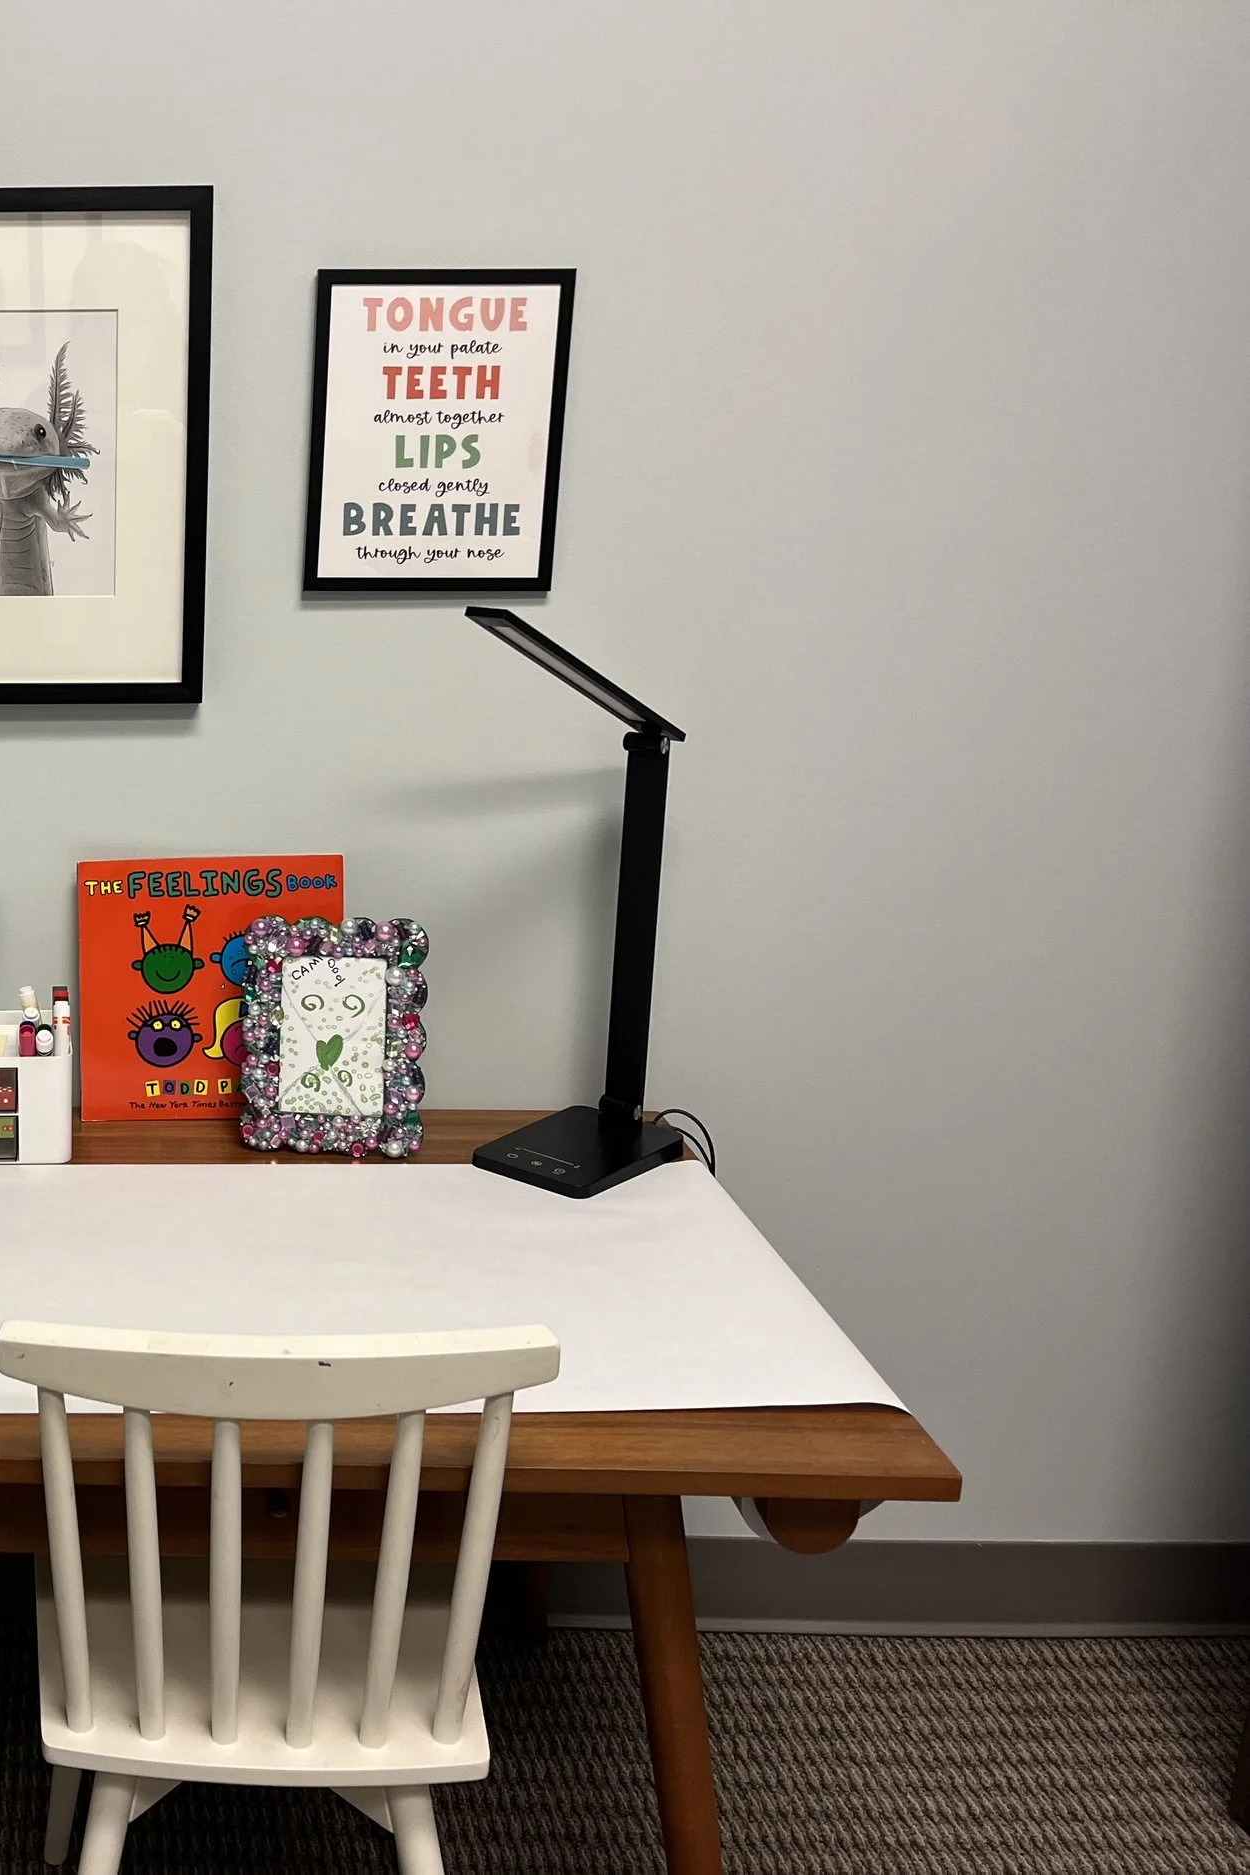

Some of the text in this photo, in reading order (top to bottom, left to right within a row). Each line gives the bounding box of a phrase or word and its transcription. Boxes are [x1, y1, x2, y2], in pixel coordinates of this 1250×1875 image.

[362, 296, 528, 333] TONGUE
[383, 340, 502, 359] in your palate
[382, 365, 501, 400] TEETH
[373, 409, 505, 429] almost together
[394, 434, 481, 470] LIPS
[378, 478, 490, 497] closed gently
[342, 502, 521, 537] BREATHE
[355, 545, 505, 564] through your nose
[84, 868, 338, 899] THE FEELINGS BOOK
[146, 1080, 206, 1096] TODD
